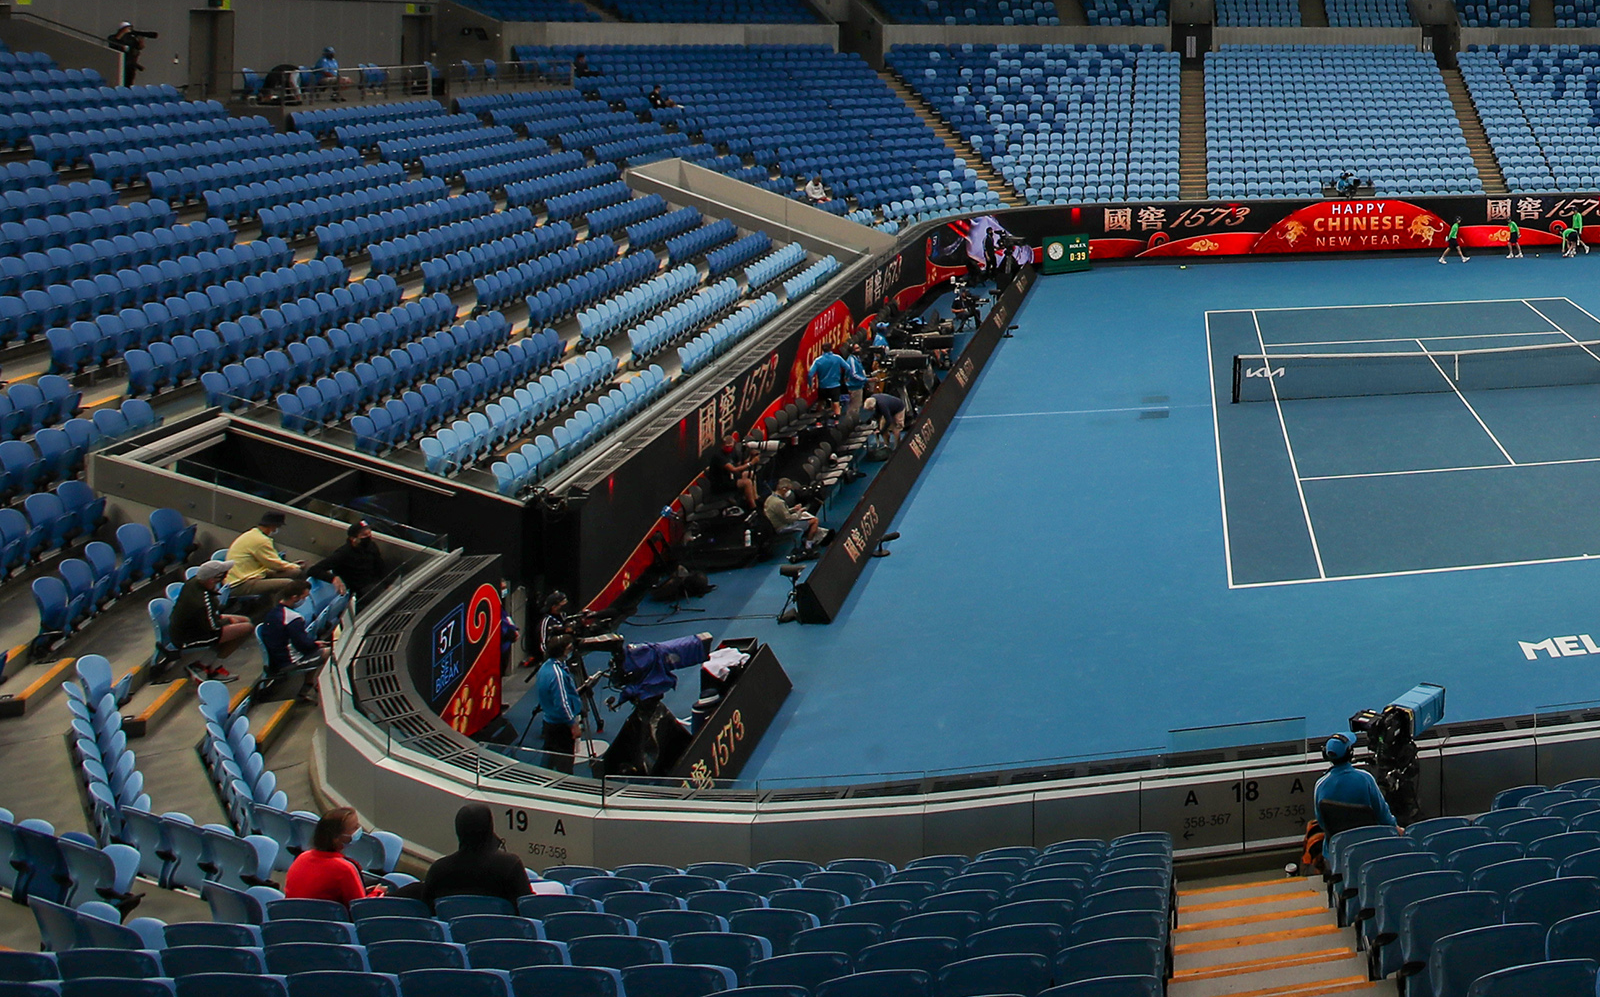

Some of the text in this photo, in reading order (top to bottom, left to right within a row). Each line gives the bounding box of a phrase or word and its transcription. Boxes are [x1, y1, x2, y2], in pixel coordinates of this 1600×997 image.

[1331, 202, 1386, 215] HAPPY
[1313, 215, 1404, 232] CHINESE
[1316, 235, 1400, 247] NEW YEAR
[814, 307, 836, 338] HAPPY
[440, 620, 456, 654] 57
[436, 661, 460, 694] BREAK
[1184, 778, 1305, 807] A 18 A
[505, 808, 567, 837] 19 A
[1183, 805, 1306, 830] 358-367 357-336
[528, 842, 568, 860] 367-358
